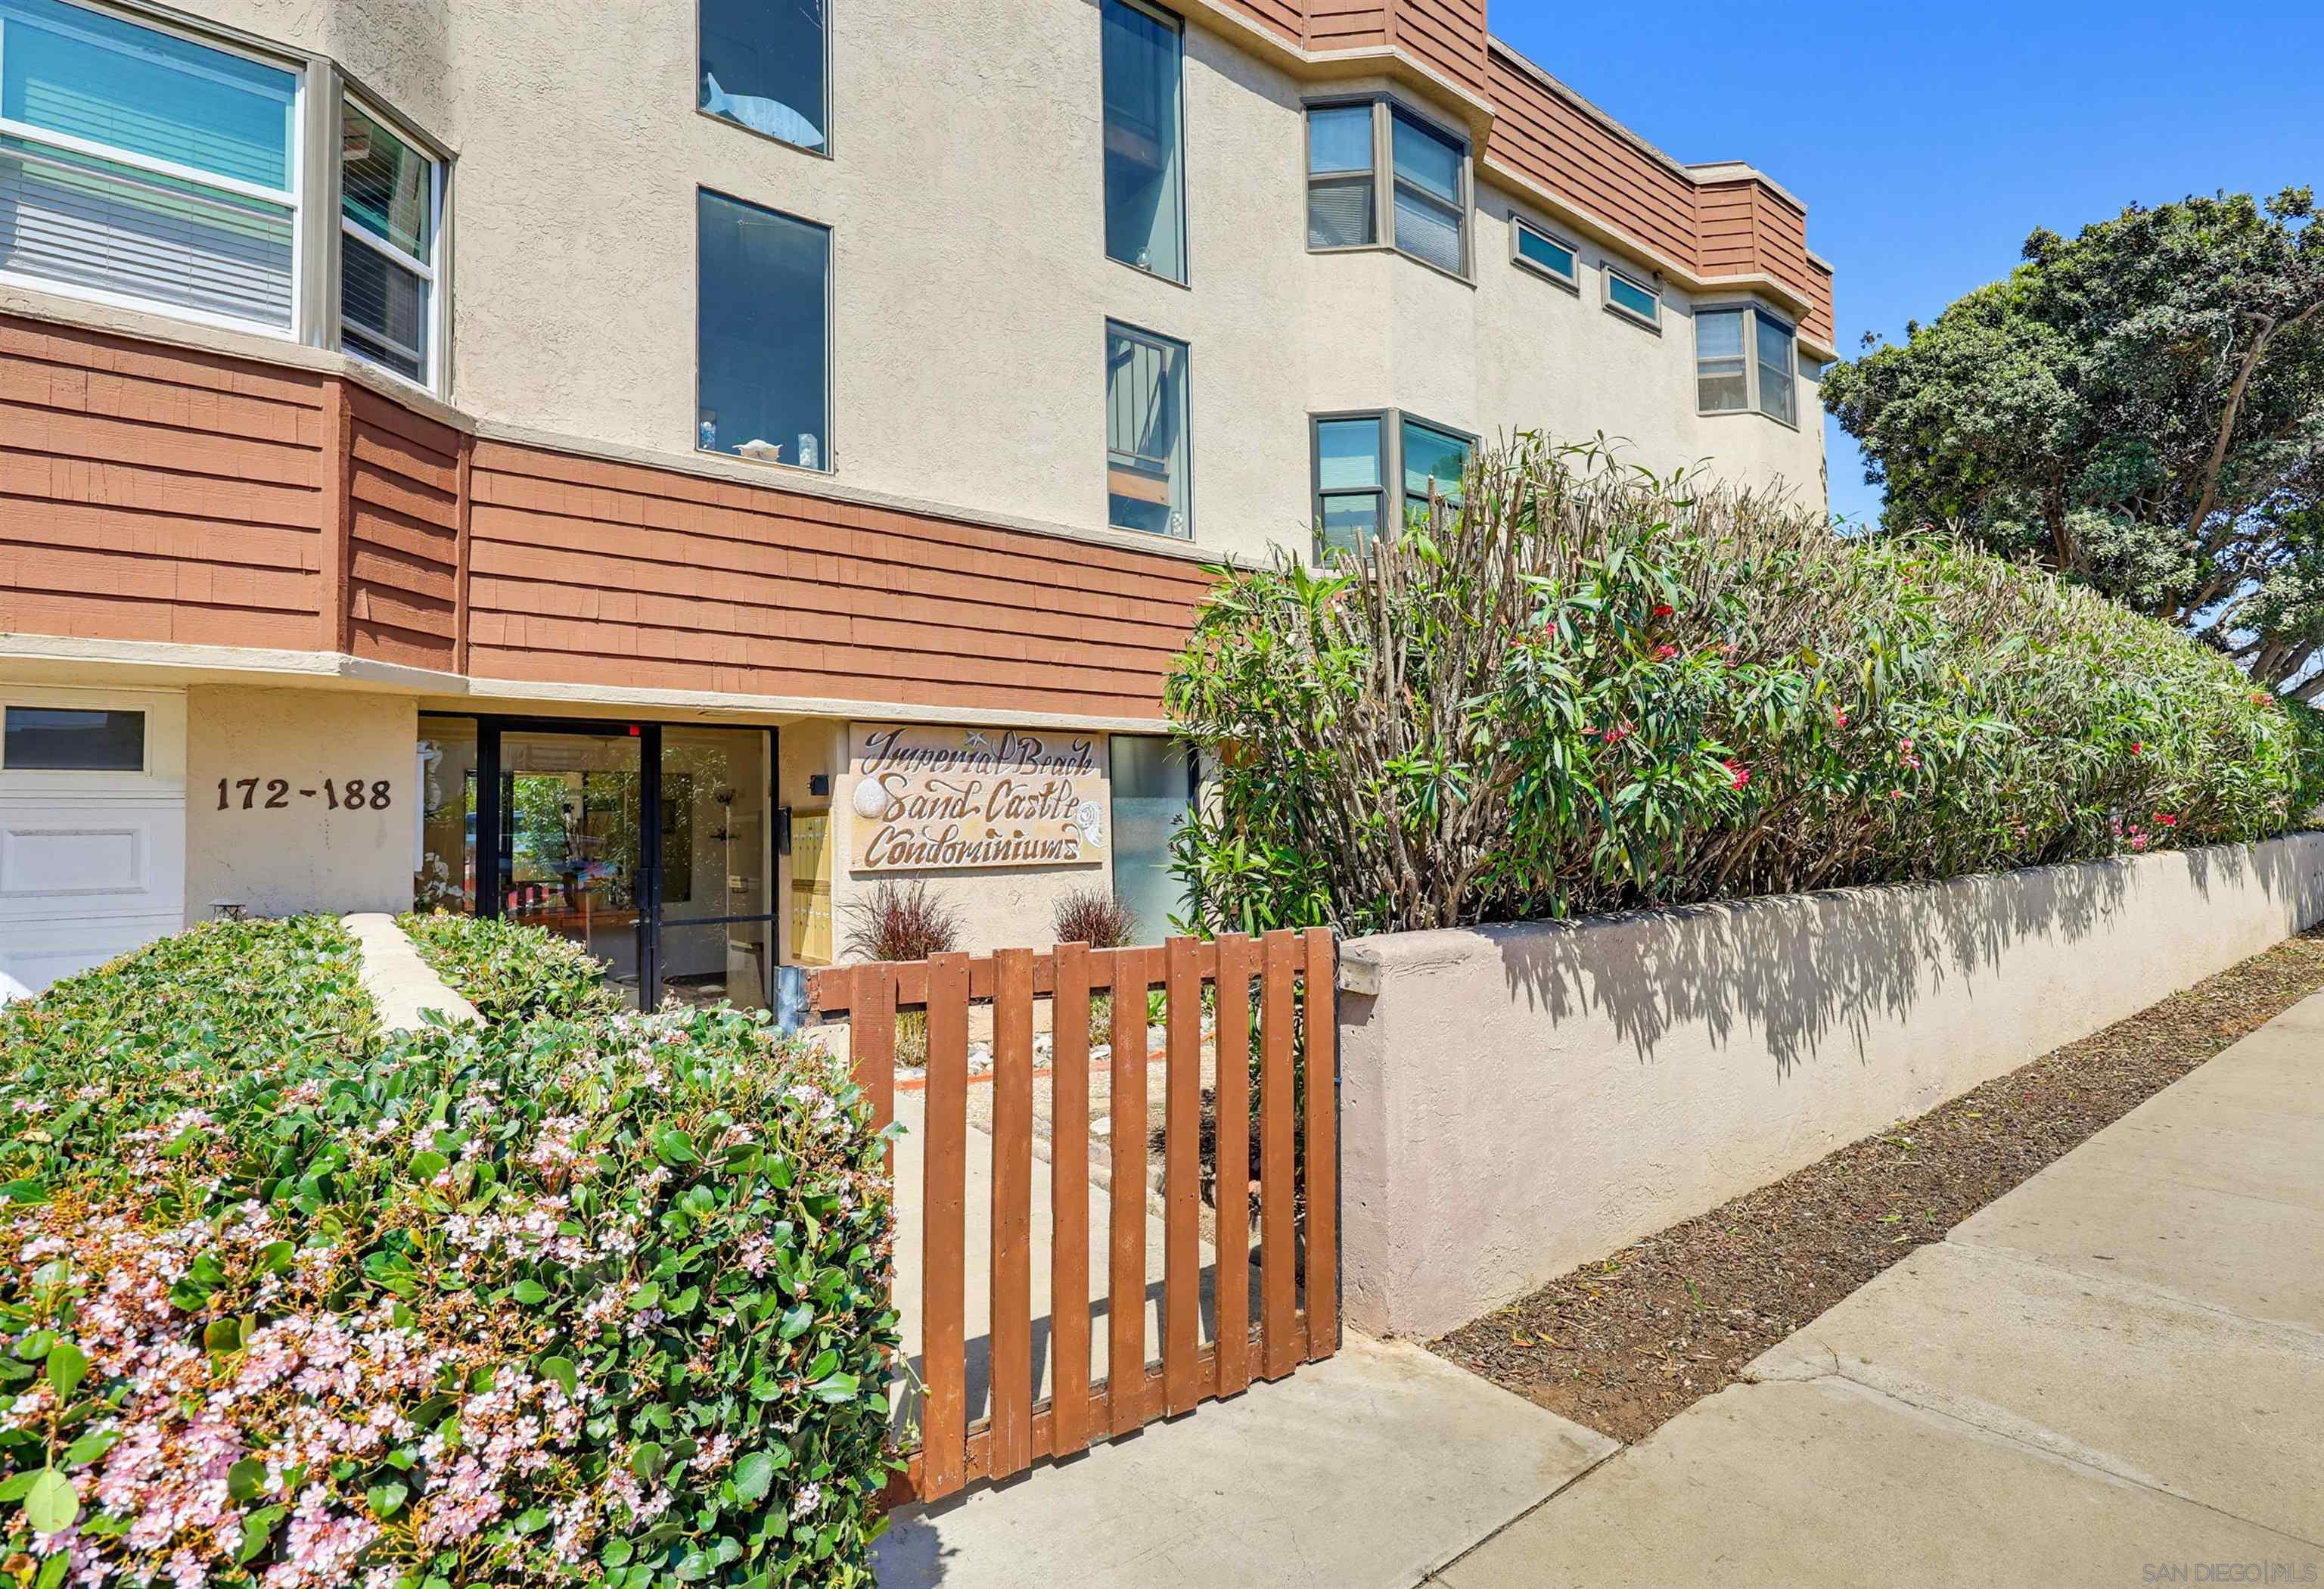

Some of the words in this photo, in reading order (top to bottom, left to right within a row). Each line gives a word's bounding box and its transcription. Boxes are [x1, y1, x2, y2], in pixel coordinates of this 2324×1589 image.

[861, 727, 1017, 776] Imperial
[1015, 735, 1097, 777] Beach
[216, 777, 391, 811] 172-188
[878, 772, 983, 823] Sand
[984, 777, 1080, 823] Castle
[863, 822, 1083, 869] Condominiums
